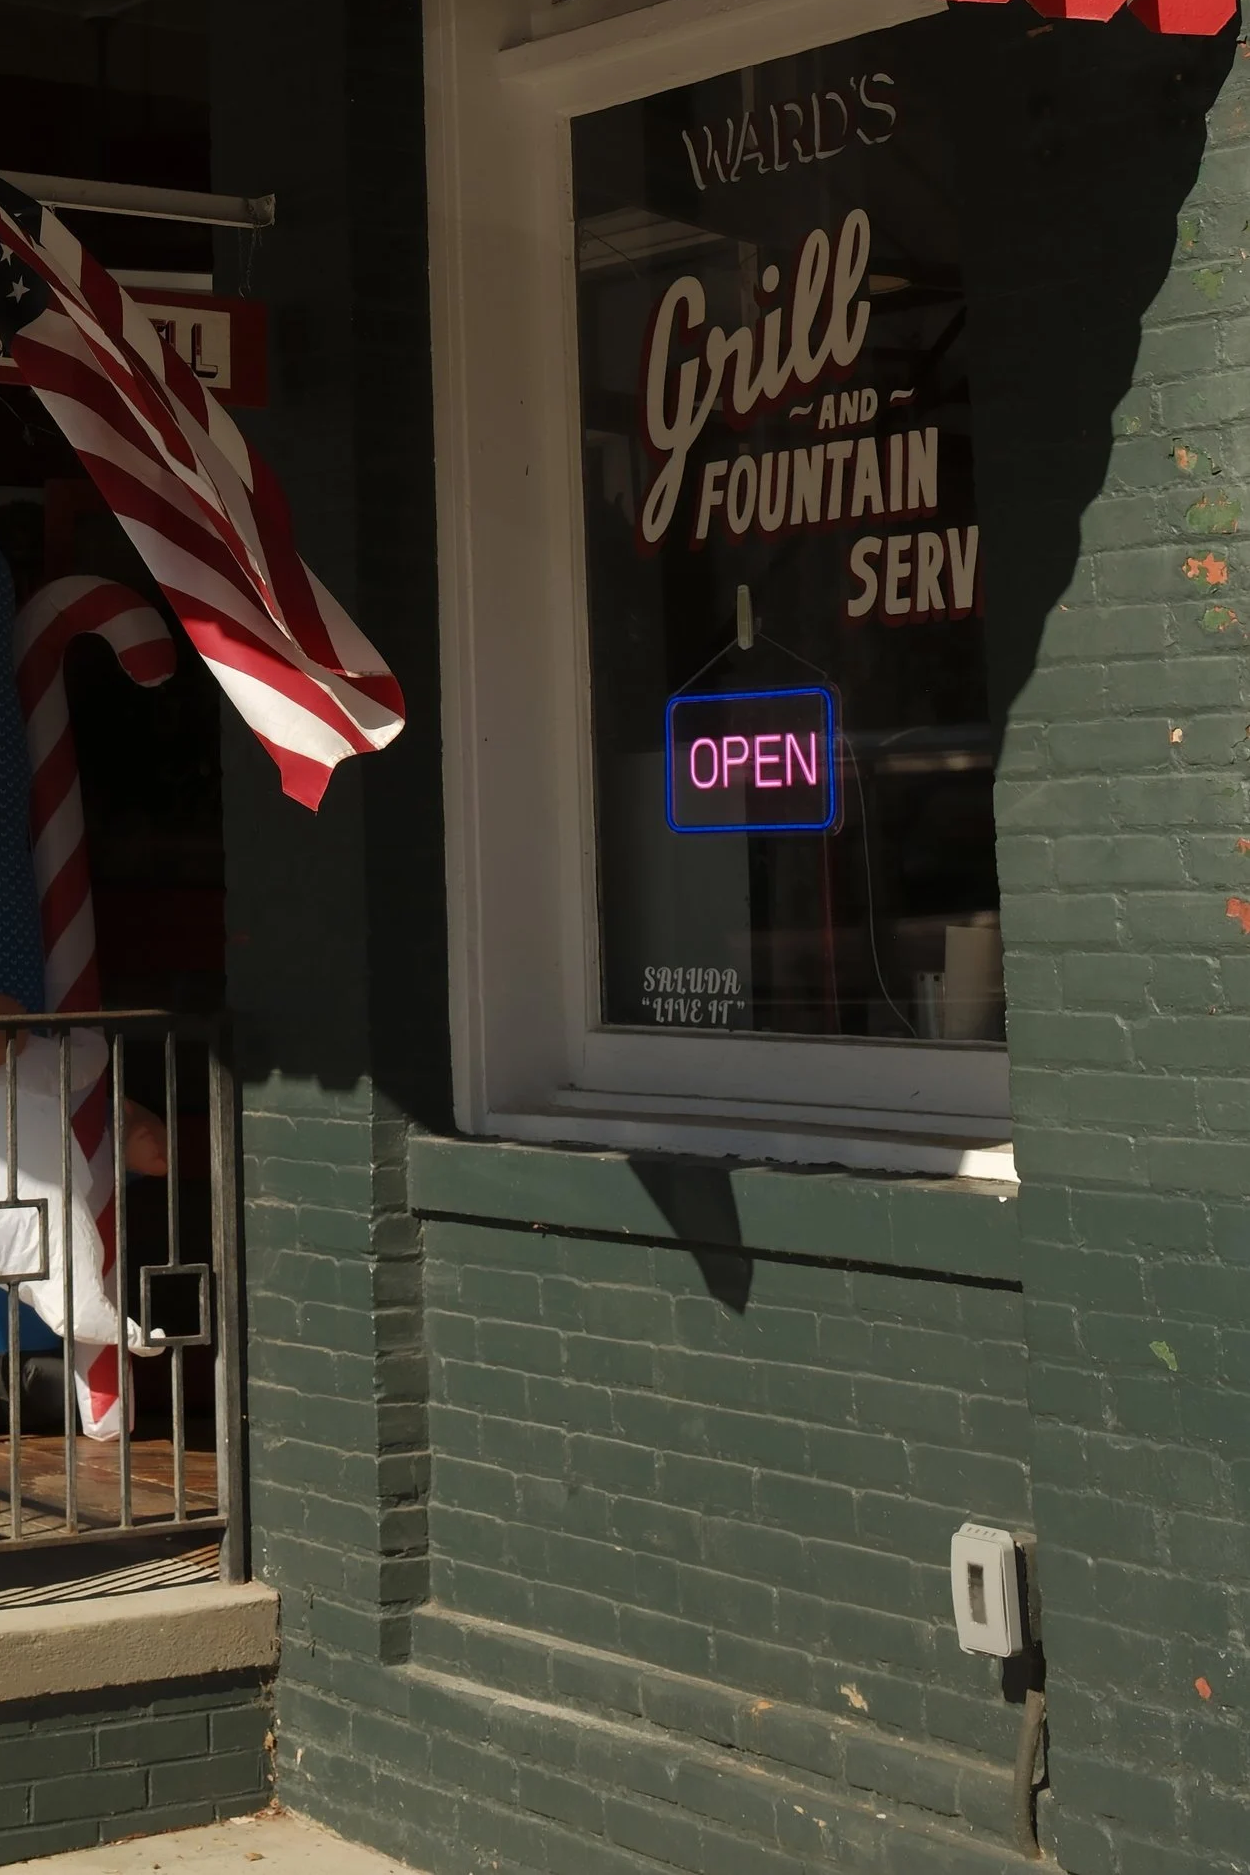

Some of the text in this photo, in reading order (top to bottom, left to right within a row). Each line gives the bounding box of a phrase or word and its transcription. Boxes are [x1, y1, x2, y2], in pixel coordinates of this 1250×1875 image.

[680, 72, 897, 192] WARD'S
[642, 208, 872, 544] Grill
[696, 427, 939, 540] FOUNTAIN
[689, 730, 818, 790] OPEN
[643, 966, 743, 996] SALUDA
